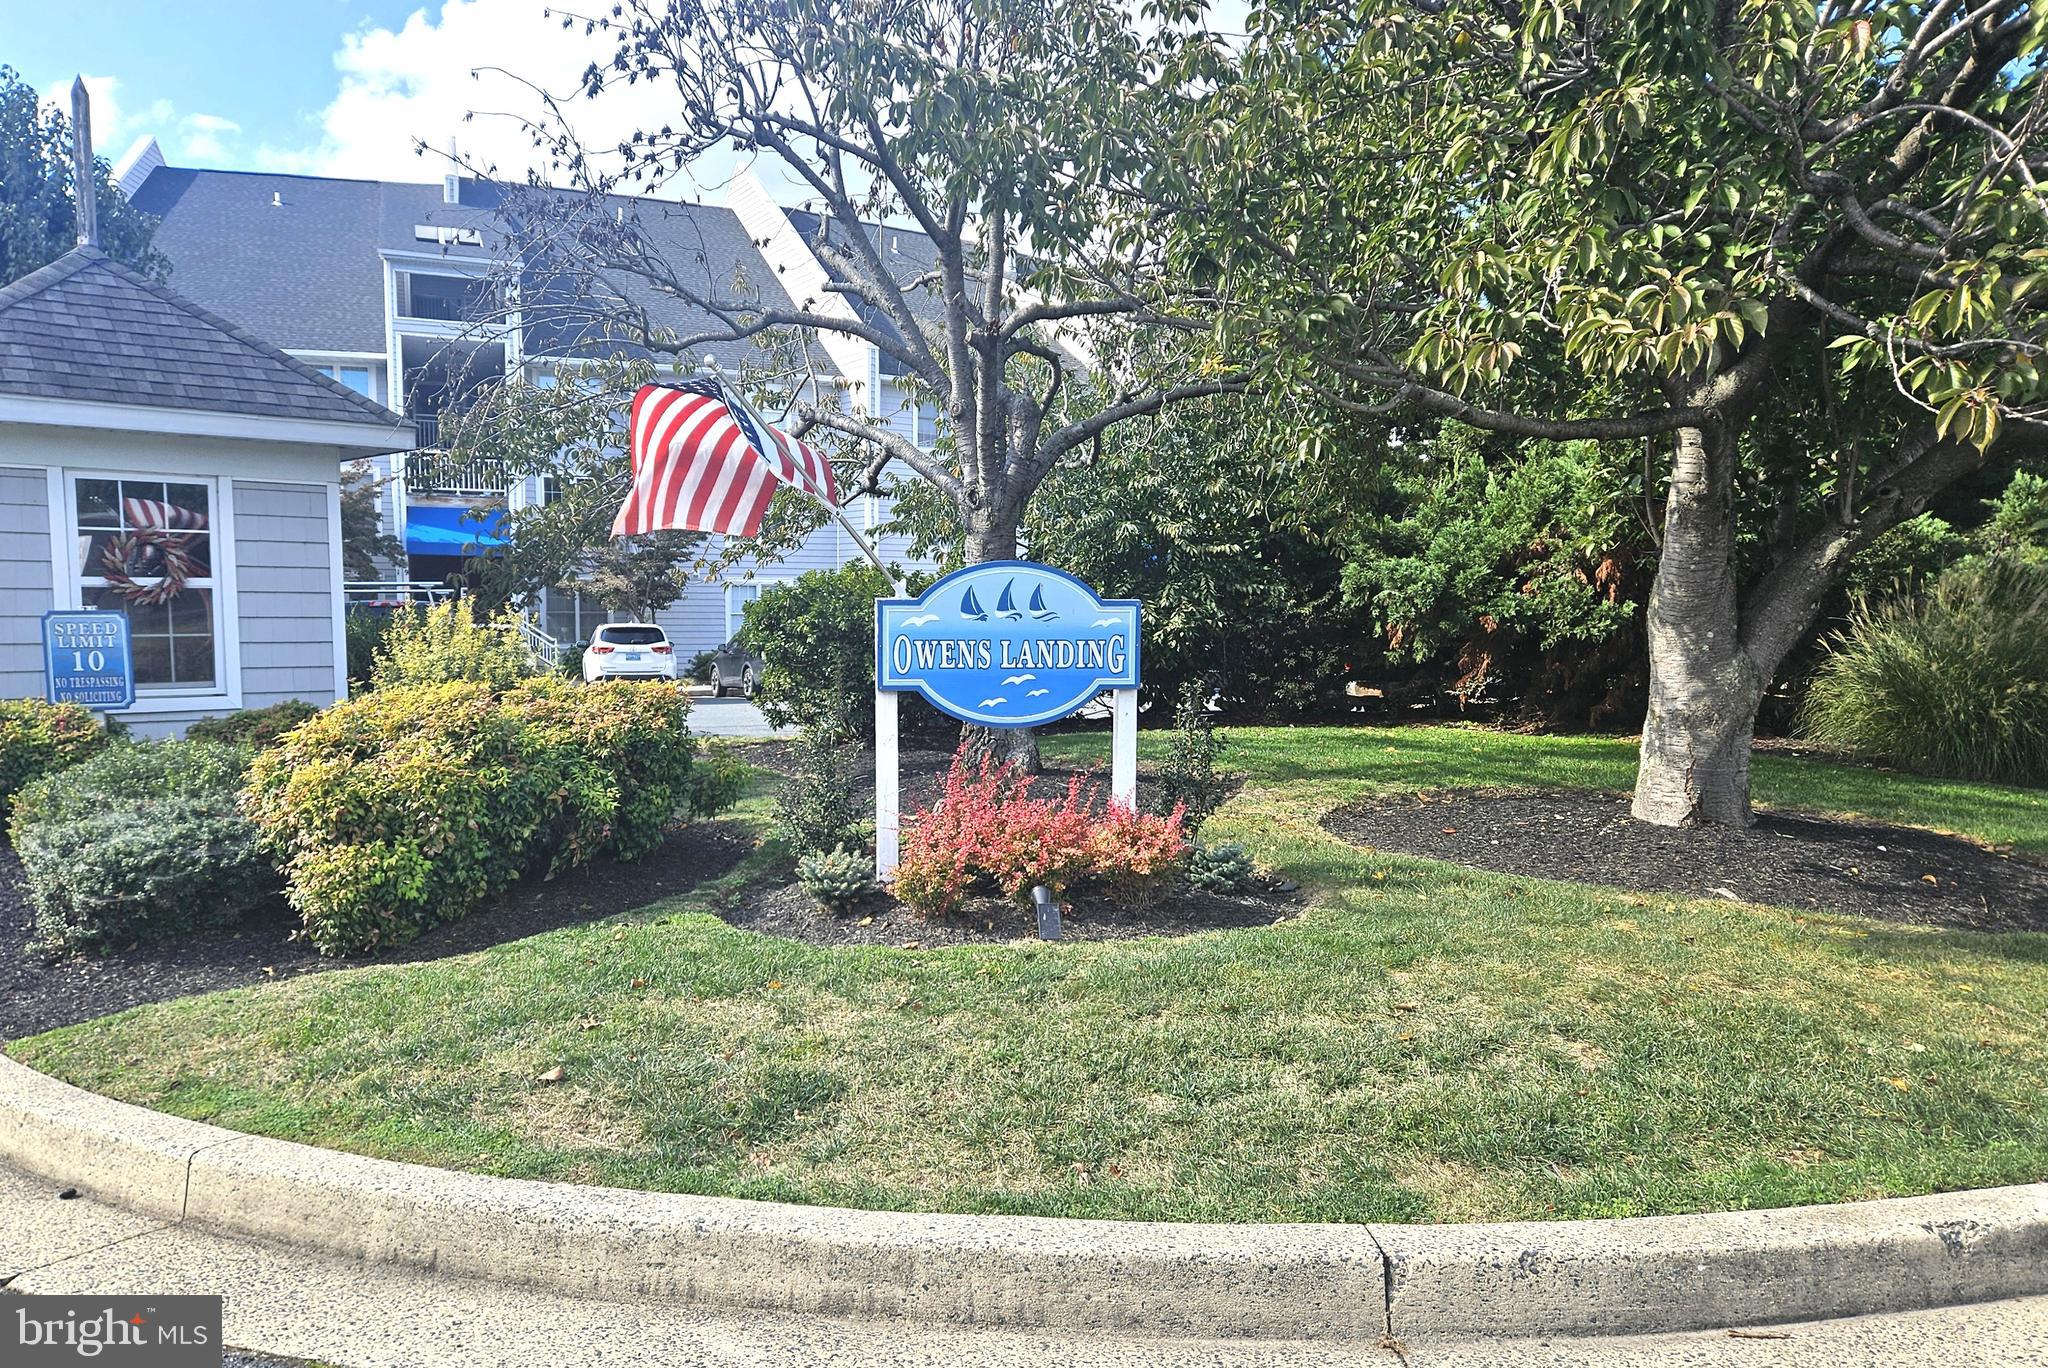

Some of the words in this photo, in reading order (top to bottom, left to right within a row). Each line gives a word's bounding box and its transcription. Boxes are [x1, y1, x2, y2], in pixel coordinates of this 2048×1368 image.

[54, 622, 118, 635] SPEED
[58, 635, 116, 648] LIMIT
[893, 633, 992, 675] OWENS
[1000, 633, 1126, 674] LANDING
[72, 650, 105, 672] 10
[55, 677, 67, 689] NO
[69, 676, 125, 688] TRESPASSING
[60, 691, 72, 701] NO
[74, 690, 122, 702] SOLICITING
